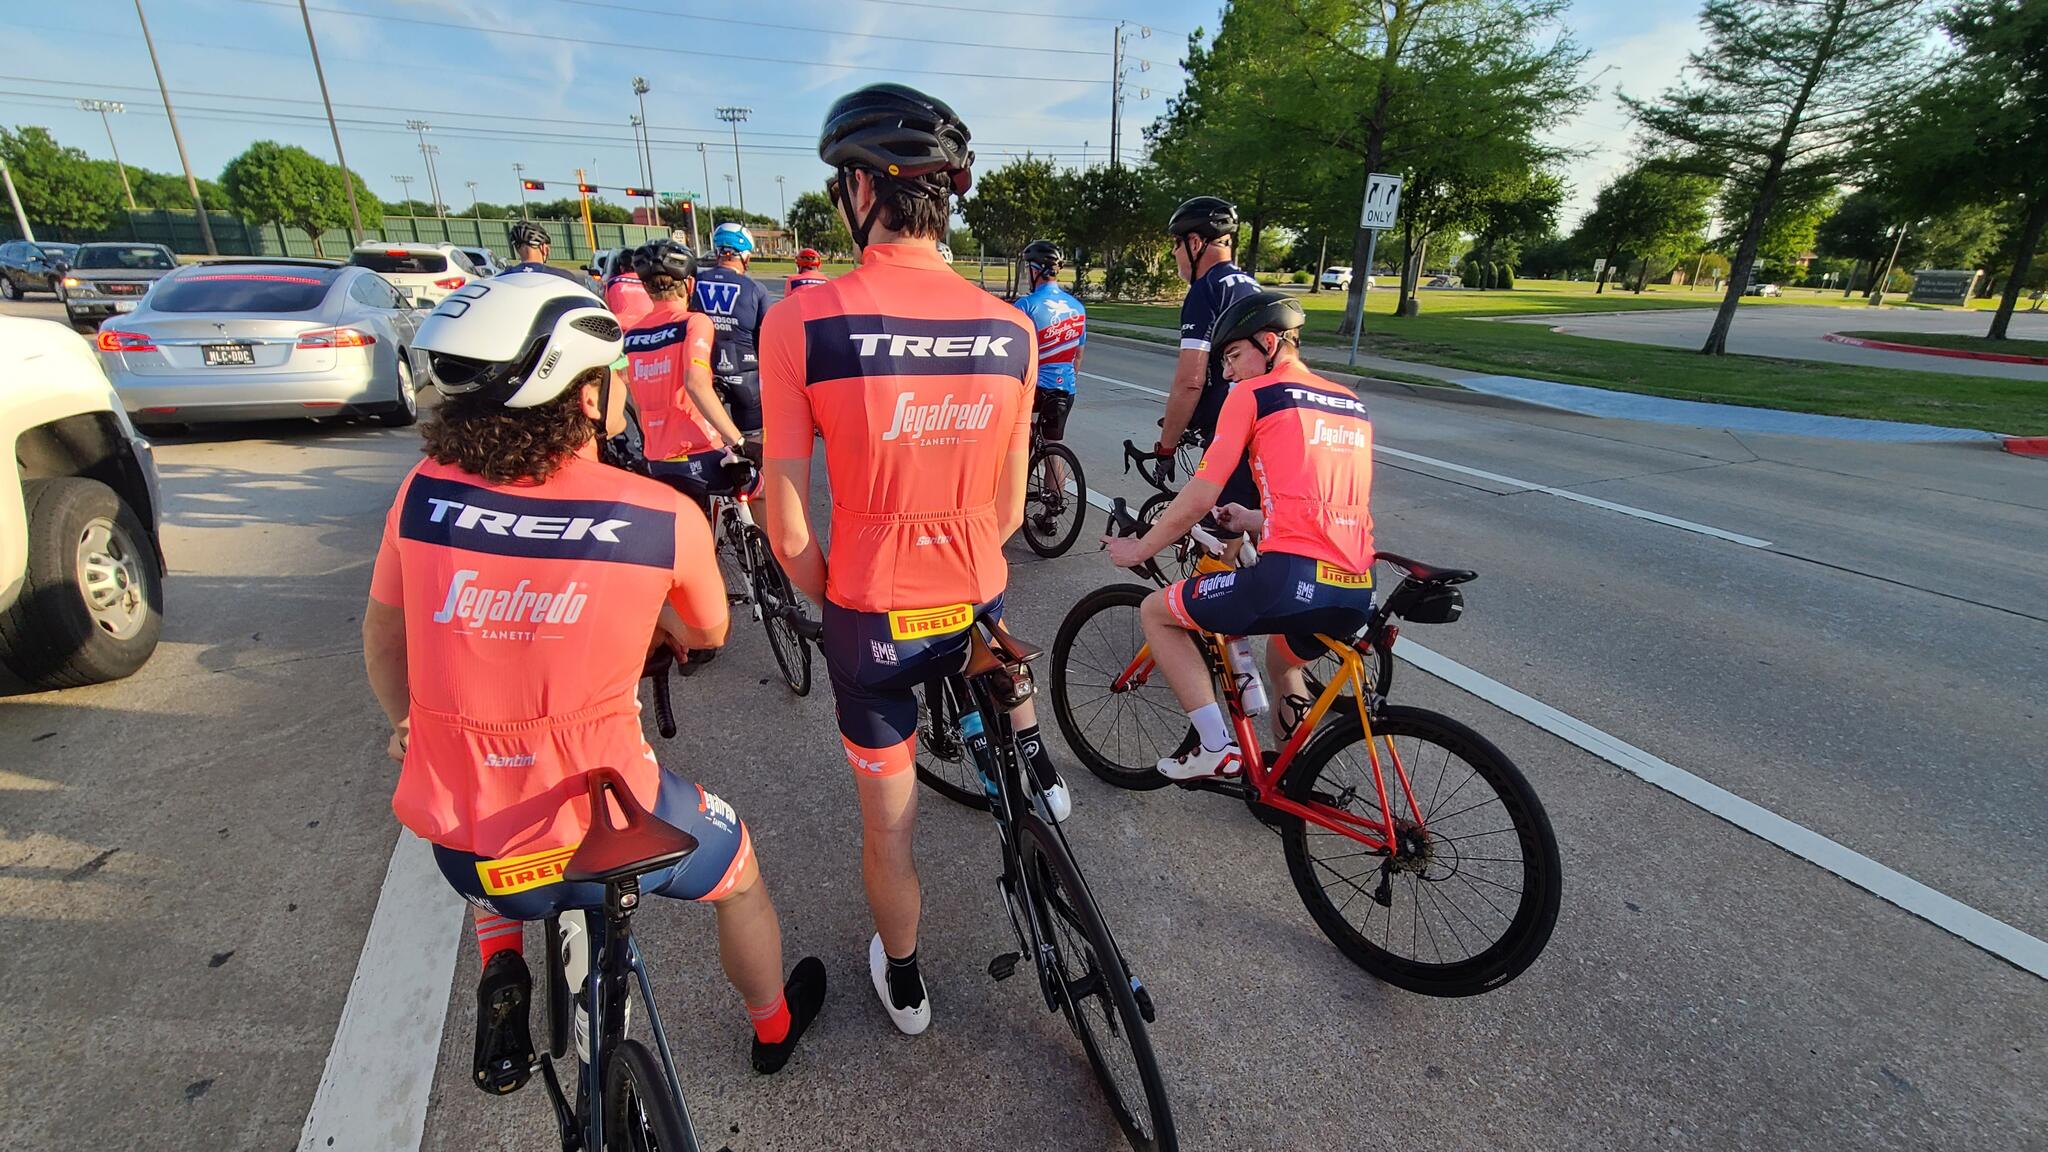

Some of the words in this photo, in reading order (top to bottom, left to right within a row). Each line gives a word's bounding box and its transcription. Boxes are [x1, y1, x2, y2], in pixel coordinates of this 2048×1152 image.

[1367, 210, 1392, 223] ONLY
[697, 281, 741, 315] W
[710, 316, 739, 326] NDSOR
[714, 323, 733, 332] OOR
[625, 327, 678, 347] TREK
[850, 333, 1013, 358] TREK
[1284, 388, 1367, 414] TREK
[882, 391, 993, 441] Segafredo
[920, 437, 960, 447] ZANETTI
[1309, 418, 1365, 448] Segafredo
[428, 497, 632, 543] TREK
[1192, 571, 1236, 599] Segafredo
[1322, 565, 1368, 584] PIRELLI
[434, 569, 588, 628] Segafredo
[898, 605, 967, 634] PIRELLI
[482, 630, 535, 641] ZANETTI
[484, 752, 537, 767] Santini
[845, 746, 887, 773] EK
[487, 849, 577, 889] PIREL
